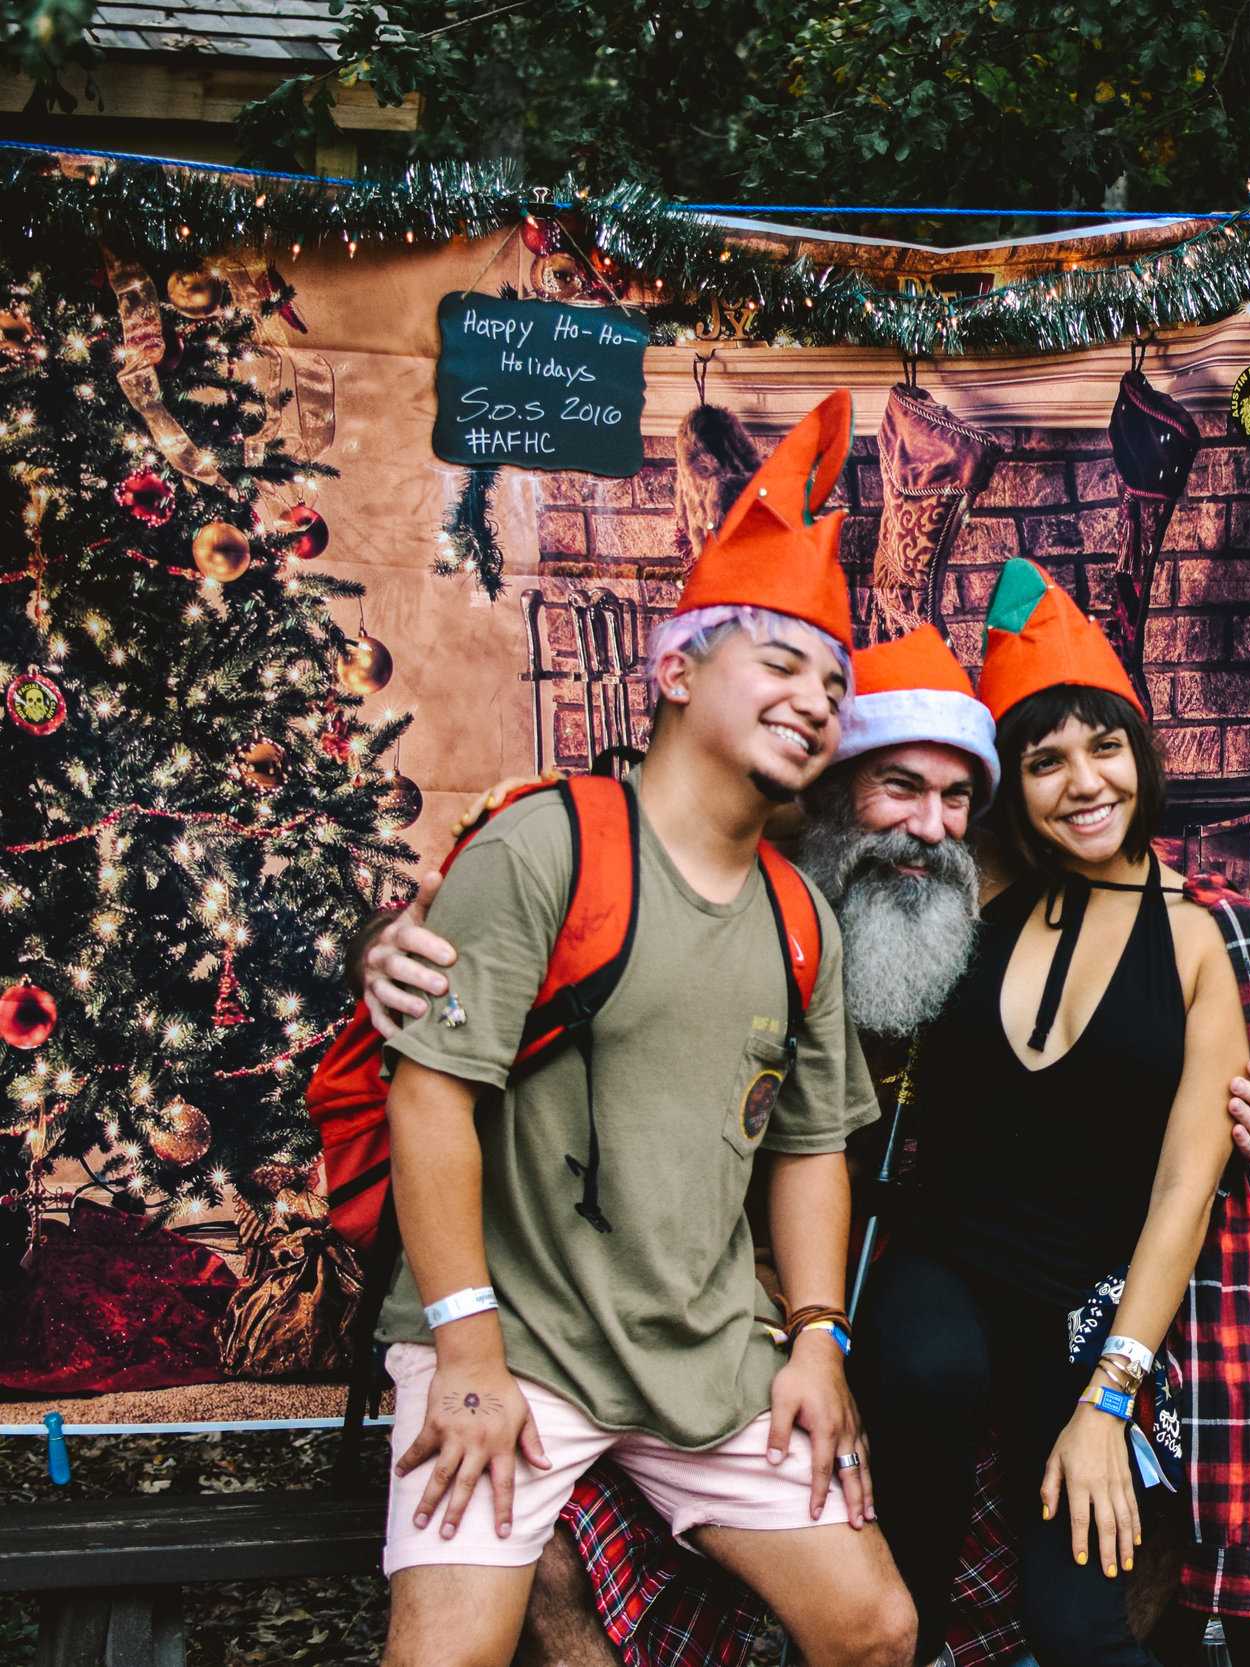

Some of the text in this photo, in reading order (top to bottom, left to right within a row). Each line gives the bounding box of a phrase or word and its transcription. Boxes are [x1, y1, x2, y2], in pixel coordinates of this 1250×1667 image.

[463, 309, 534, 348] Happy
[500, 351, 596, 387] Holidays
[560, 397, 622, 425] 2016
[1231, 373, 1248, 417] AUSTIN
[465, 427, 555, 454] #AFHC
